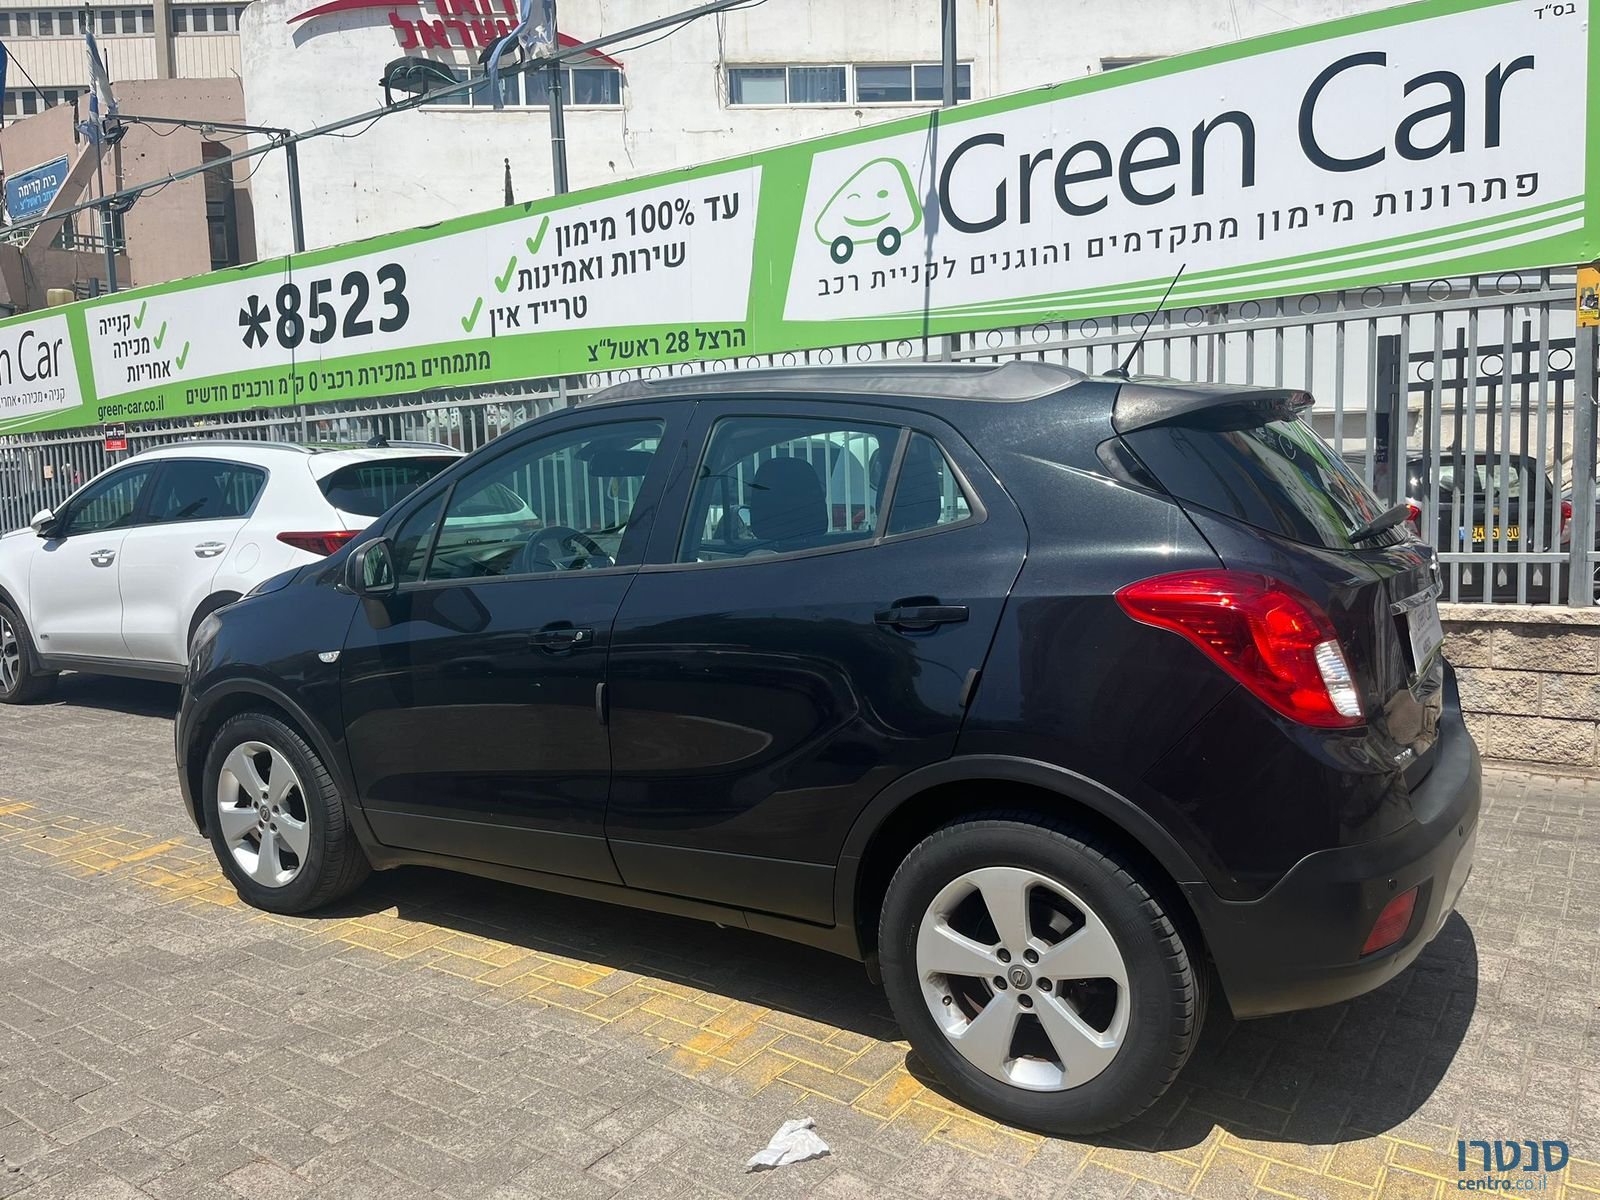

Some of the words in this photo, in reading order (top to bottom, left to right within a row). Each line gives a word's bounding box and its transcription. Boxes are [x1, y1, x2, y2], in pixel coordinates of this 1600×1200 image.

[938, 110, 1256, 234] Green
[1298, 51, 1535, 172] Car
[18, 179, 41, 198] קדימה
[42, 174, 57, 189] בית
[704, 192, 739, 221] עד
[1372, 172, 1539, 217] פתרונות
[625, 198, 695, 236] 100%
[1257, 199, 1353, 240] מימון
[555, 217, 616, 256] מימון
[1087, 217, 1239, 259] מתקדמים
[610, 242, 686, 277] שירות
[970, 242, 1071, 275] והוגנים
[518, 256, 603, 292] ואמינות
[870, 255, 957, 289] לקניית
[818, 274, 859, 296] רכב
[489, 305, 520, 337] אין
[527, 294, 588, 324] טרייד
[99, 314, 131, 336] קנייה
[113, 337, 150, 359] מכירה
[588, 337, 659, 362] ראשל"צ
[665, 331, 689, 354] 28
[695, 328, 746, 350] הרצל
[18, 330, 63, 382] Car
[421, 350, 491, 377] מתמחים
[126, 360, 172, 383] אחריות
[309, 371, 318, 392] 0
[321, 370, 354, 390] רכבי
[358, 361, 417, 385] במכירת
[48, 388, 65, 404] קניה
[186, 384, 228, 405] חדשים
[232, 379, 274, 400] ורכבים
[97, 395, 165, 420] green-car.co.il
